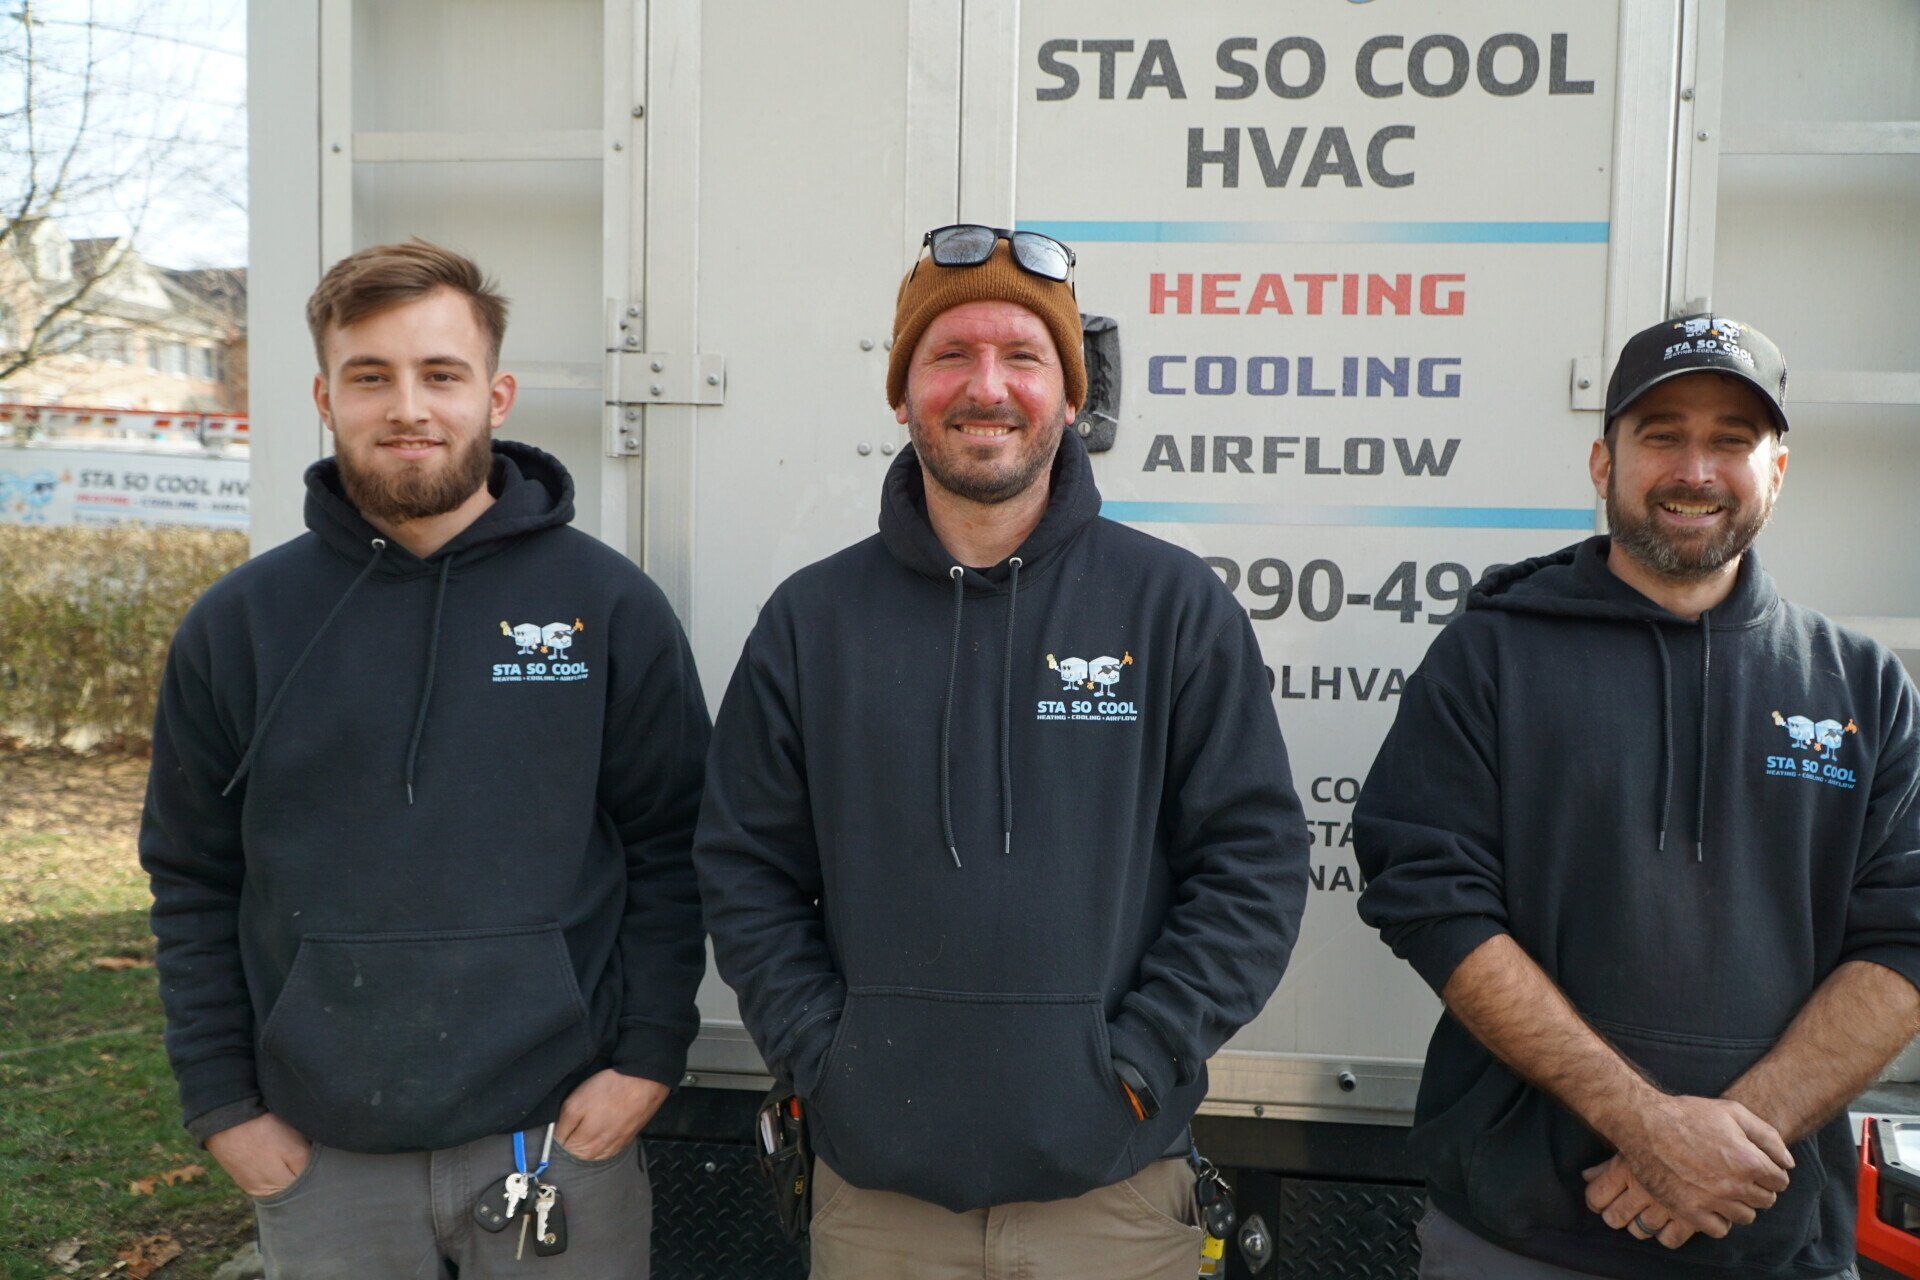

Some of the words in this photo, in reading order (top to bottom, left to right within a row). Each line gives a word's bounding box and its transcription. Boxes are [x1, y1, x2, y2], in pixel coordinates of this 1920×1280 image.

[1036, 39, 1186, 101] STA
[1214, 37, 1327, 99] SO
[1355, 33, 1596, 97] COOL
[1186, 125, 1416, 189] HVAC
[1149, 273, 1466, 316] HEATING
[1665, 341, 1691, 356] STA
[1696, 339, 1717, 349] SO
[1148, 355, 1462, 398] COOLING
[1142, 434, 1462, 477] AIRFLOW
[79, 469, 115, 488] STA
[122, 471, 148, 491] SO
[155, 474, 212, 495] COOL
[1200, 556, 1505, 625] 90-49
[492, 664, 521, 676] STA
[526, 663, 547, 675] SO
[552, 662, 589, 675] COOL
[559, 673, 588, 682] AIRFLOW
[1037, 701, 1066, 713] STA
[1071, 701, 1092, 713] SO
[1098, 702, 1138, 714] COOL
[1766, 755, 1797, 770] STA
[1802, 759, 1819, 774] SO
[1823, 764, 1857, 783] COOL
[1766, 769, 1797, 777] HEATING
[1311, 776, 1361, 804] CO
[1308, 865, 1366, 893] NA
